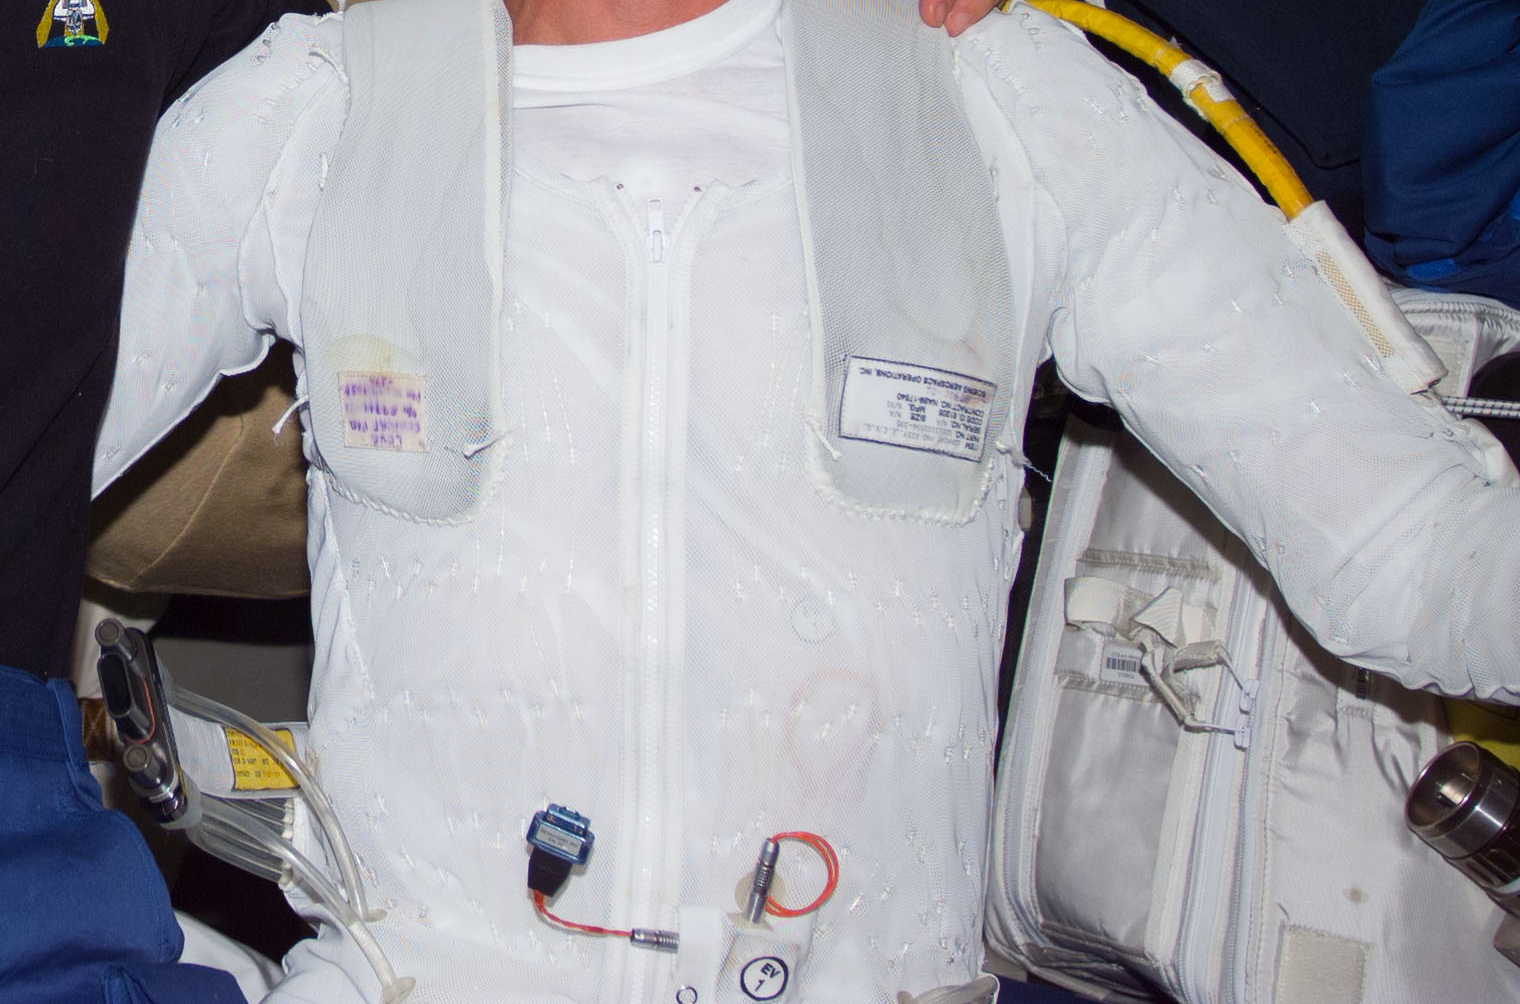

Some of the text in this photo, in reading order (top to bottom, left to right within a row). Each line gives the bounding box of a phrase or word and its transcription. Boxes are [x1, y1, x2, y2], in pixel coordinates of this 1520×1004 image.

[922, 377, 962, 391] AEROSPACE
[951, 403, 984, 417] CONTRACT
[966, 415, 983, 425] CODE
[760, 962, 781, 979] EV
